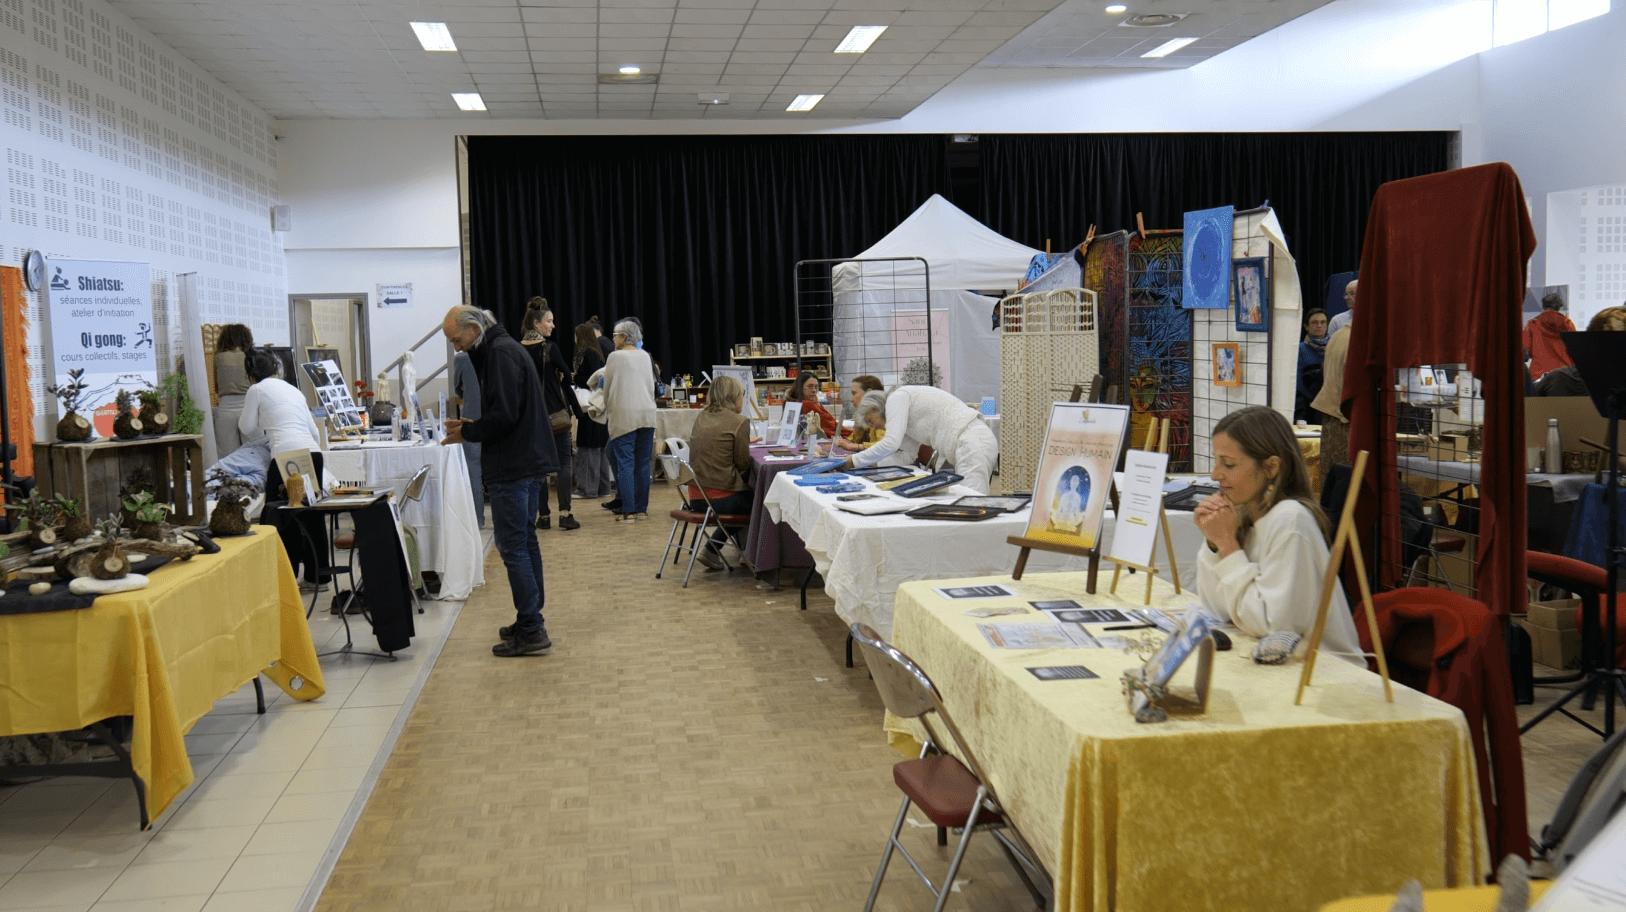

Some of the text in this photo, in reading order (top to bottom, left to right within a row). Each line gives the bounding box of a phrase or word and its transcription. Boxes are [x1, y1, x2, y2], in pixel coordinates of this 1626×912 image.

[78, 275, 124, 291] Shiatsu:
[59, 295, 143, 306] séances individuelles,
[71, 308, 135, 317] atelier d'initiation
[81, 331, 127, 349] Qi gong:
[61, 351, 147, 362] cours collectifs, stages
[1048, 445, 1113, 459] DESIGN HUMAIN
